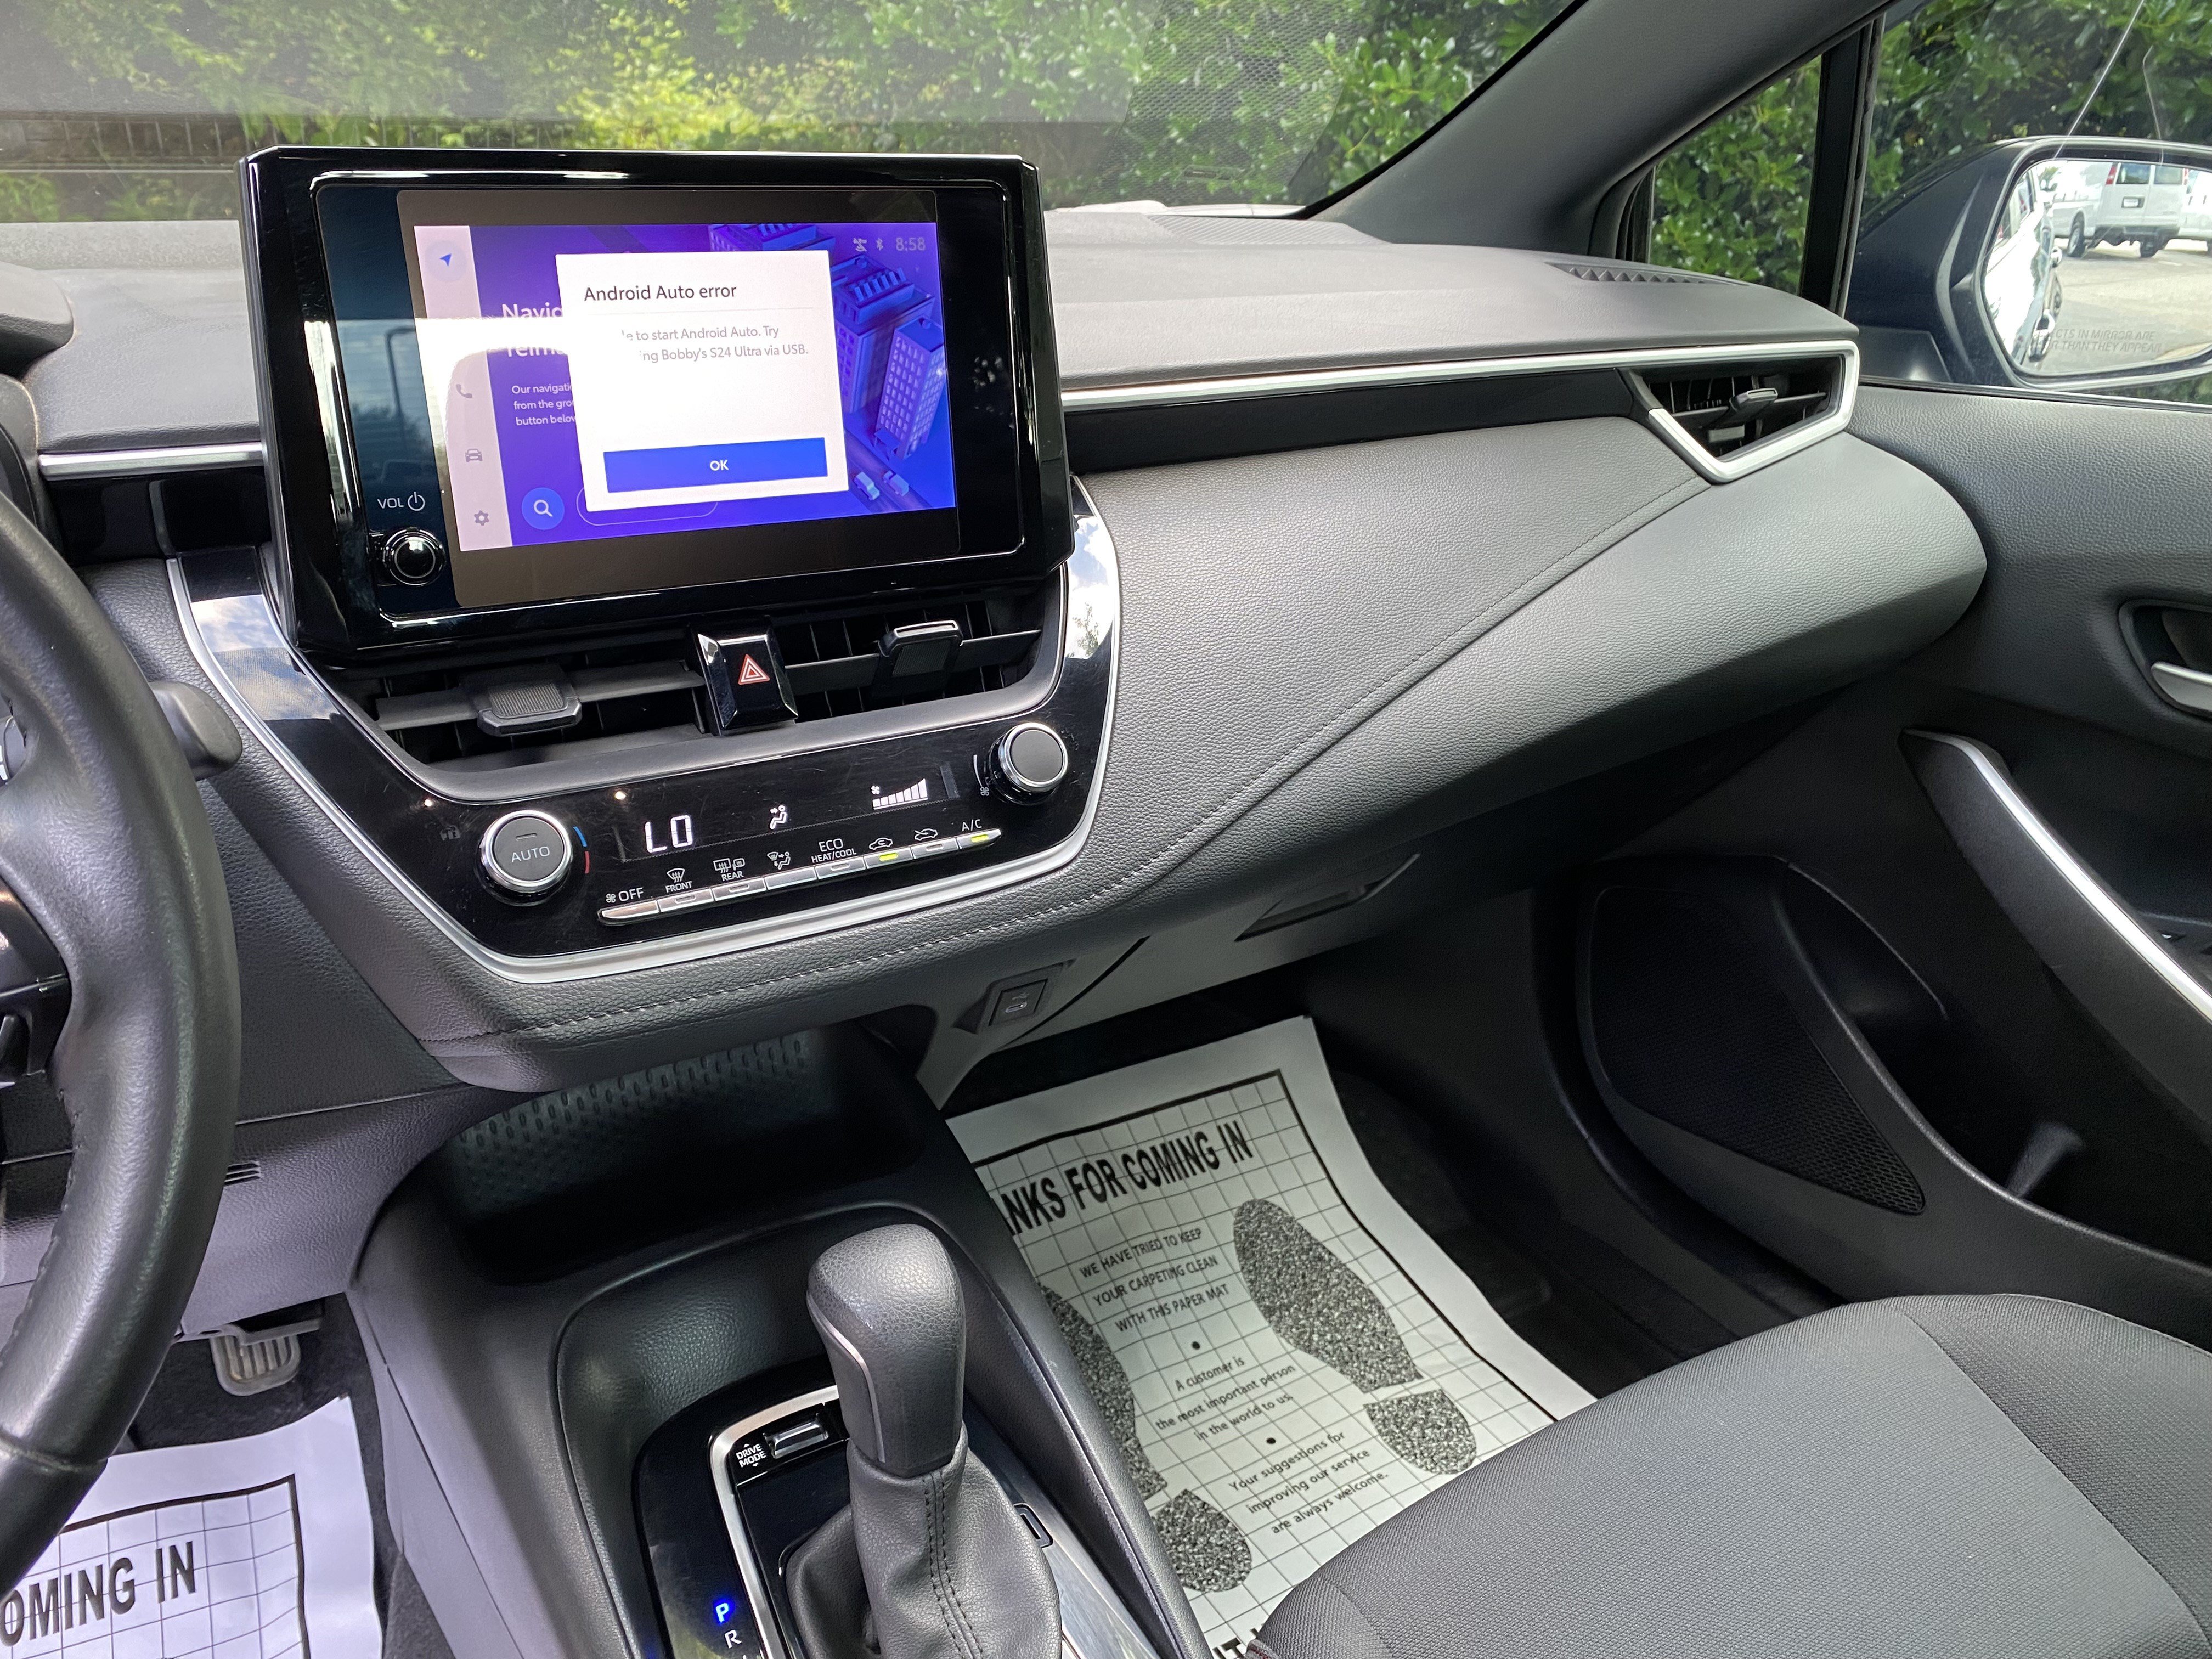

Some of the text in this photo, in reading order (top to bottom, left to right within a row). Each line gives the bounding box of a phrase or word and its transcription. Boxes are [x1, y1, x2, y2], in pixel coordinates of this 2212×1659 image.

[896, 237, 926, 251] 8:58
[584, 285, 737, 301] Android Auto error
[636, 330, 649, 340] to
[652, 330, 678, 340] start
[681, 326, 727, 339] Android
[731, 326, 761, 338] Auto.
[763, 325, 779, 338] Try
[2136, 331, 2156, 341] ARE
[662, 348, 707, 362] Bobby's
[710, 346, 731, 358] S24
[735, 345, 761, 357] Ultra
[764, 345, 780, 356] via
[782, 343, 809, 355] USB.
[2090, 341, 2119, 352] THEY
[511, 385, 529, 394] Our
[514, 399, 574, 410] from the gro
[516, 417, 548, 426] button
[710, 459, 729, 471] OK
[377, 498, 404, 509] VOL
[962, 819, 982, 832] A/C
[819, 838, 844, 853] ECO
[511, 846, 550, 863] AUTO
[811, 848, 857, 864] HEAT/COOL
[721, 871, 744, 882] REAR
[618, 887, 644, 901] OFF
[665, 881, 692, 893] FRONT
[1064, 1159, 1127, 1210] FOR
[1121, 1131, 1220, 1190] COMING
[1216, 1120, 1253, 1163] IN
[1079, 1228, 1201, 1278] WE HAVE TRIED TO KEEP
[1094, 1255, 1218, 1306] YOUR CARPETING CLEAN
[1115, 1284, 1229, 1331] WITH THIS PAPER MAT
[1175, 1356, 1245, 1391] A customer is
[1155, 1364, 1295, 1430] the most important person
[1194, 1431, 1208, 1441] in
[1209, 1422, 1229, 1435] the
[1229, 1406, 1262, 1426] world
[1262, 1401, 1275, 1410] to
[736, 1443, 763, 1460] DRIVE
[739, 1451, 766, 1468] MODE
[1229, 1431, 1345, 1491] Your suggestions for
[1246, 1449, 1370, 1514] improving our service
[1271, 1472, 1389, 1533] are always welcome.
[155, 1541, 196, 1604] IN
[715, 1602, 730, 1623] P
[724, 1629, 742, 1649] R
